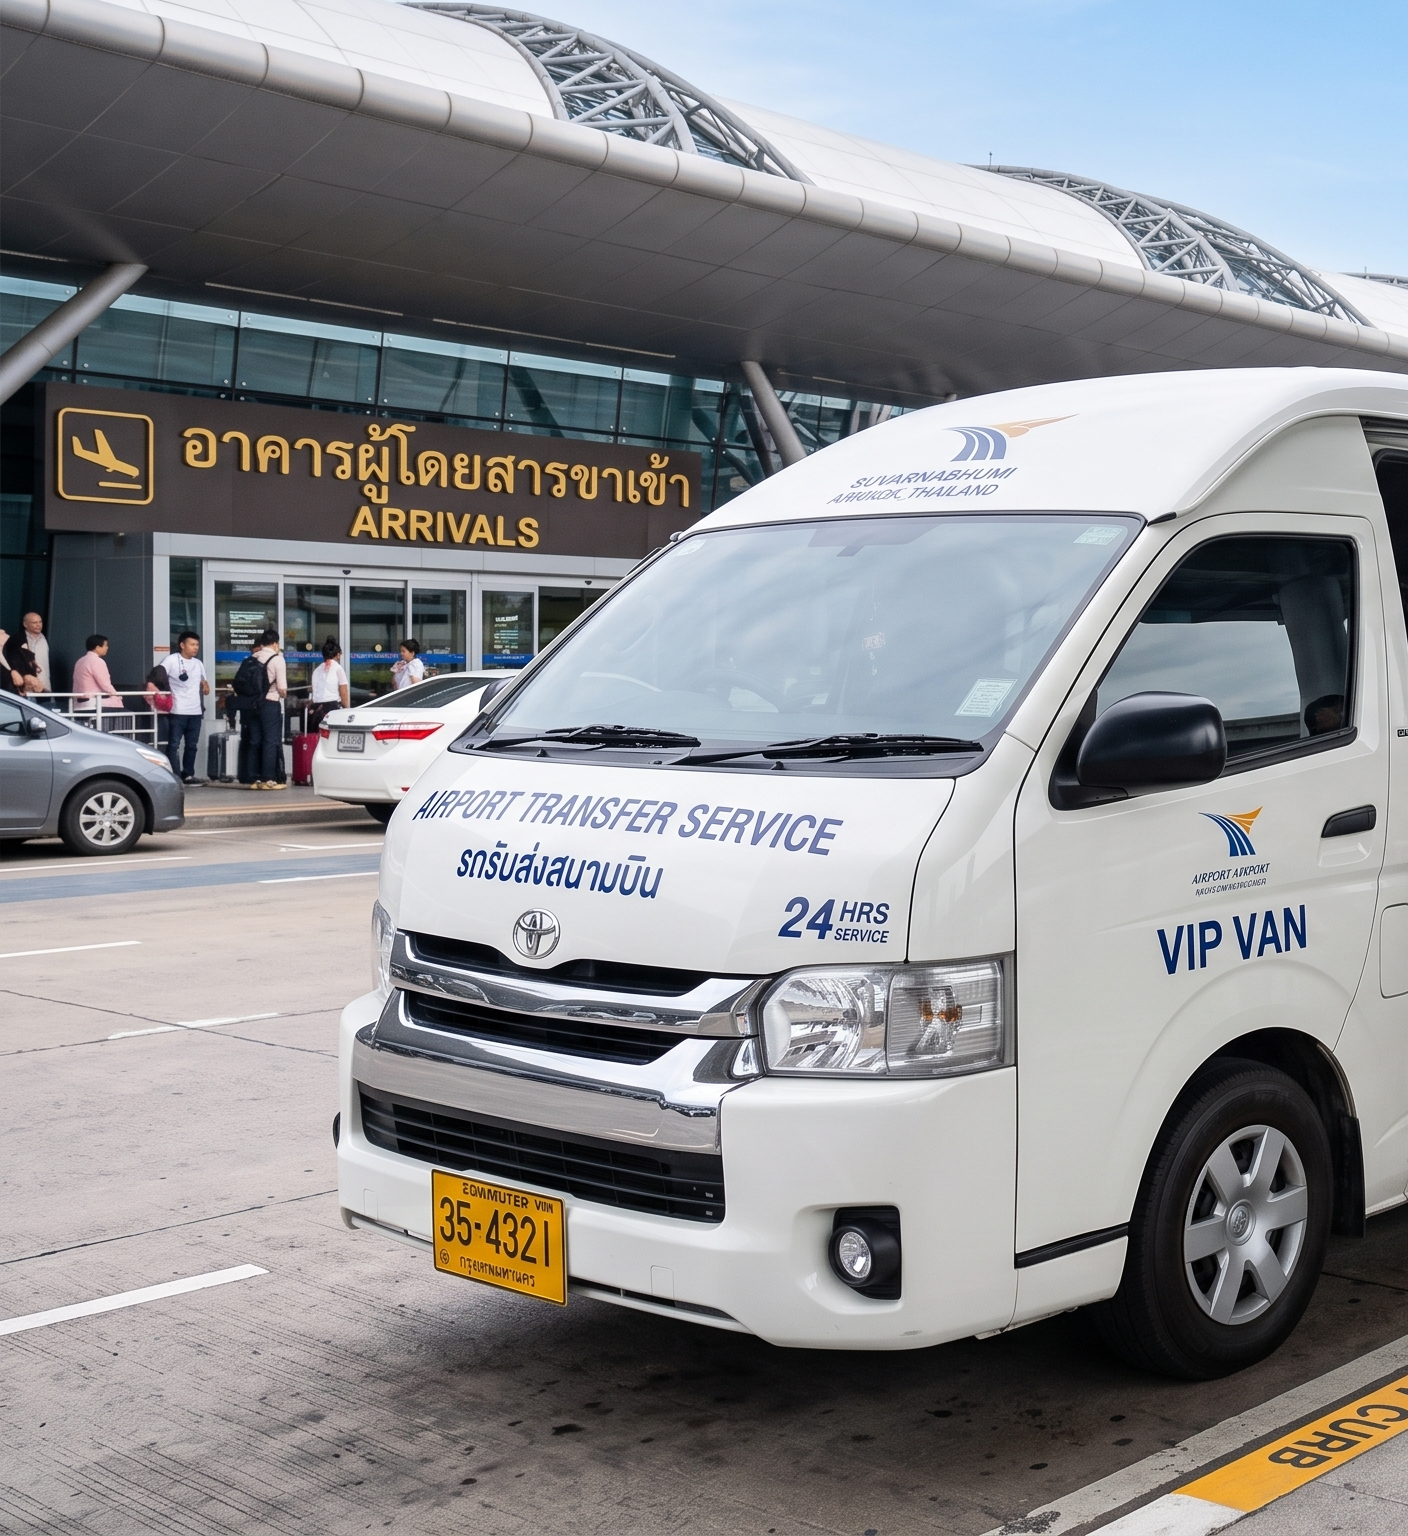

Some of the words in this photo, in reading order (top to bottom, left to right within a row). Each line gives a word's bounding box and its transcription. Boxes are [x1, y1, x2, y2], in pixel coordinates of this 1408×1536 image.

[183, 424, 690, 507] อาคารผู้โดยสารขาเข้า
[850, 467, 1018, 489] SUVARNABHUMI
[907, 484, 999, 500] THAILAND
[351, 505, 540, 548] ARRIVALS
[412, 789, 521, 821] AIRPORT
[519, 792, 681, 835] TRANSFER
[677, 803, 844, 856] SERVICE
[457, 840, 664, 899] รถรับส่งสนามบิน
[1191, 869, 1232, 885] AIRPORT
[778, 896, 835, 940] 24
[838, 900, 891, 925] HRS
[833, 926, 890, 944] SERVICE
[1157, 920, 1223, 975] VIP
[1232, 904, 1307, 960] VAN
[439, 1196, 550, 1268] 35-4321
